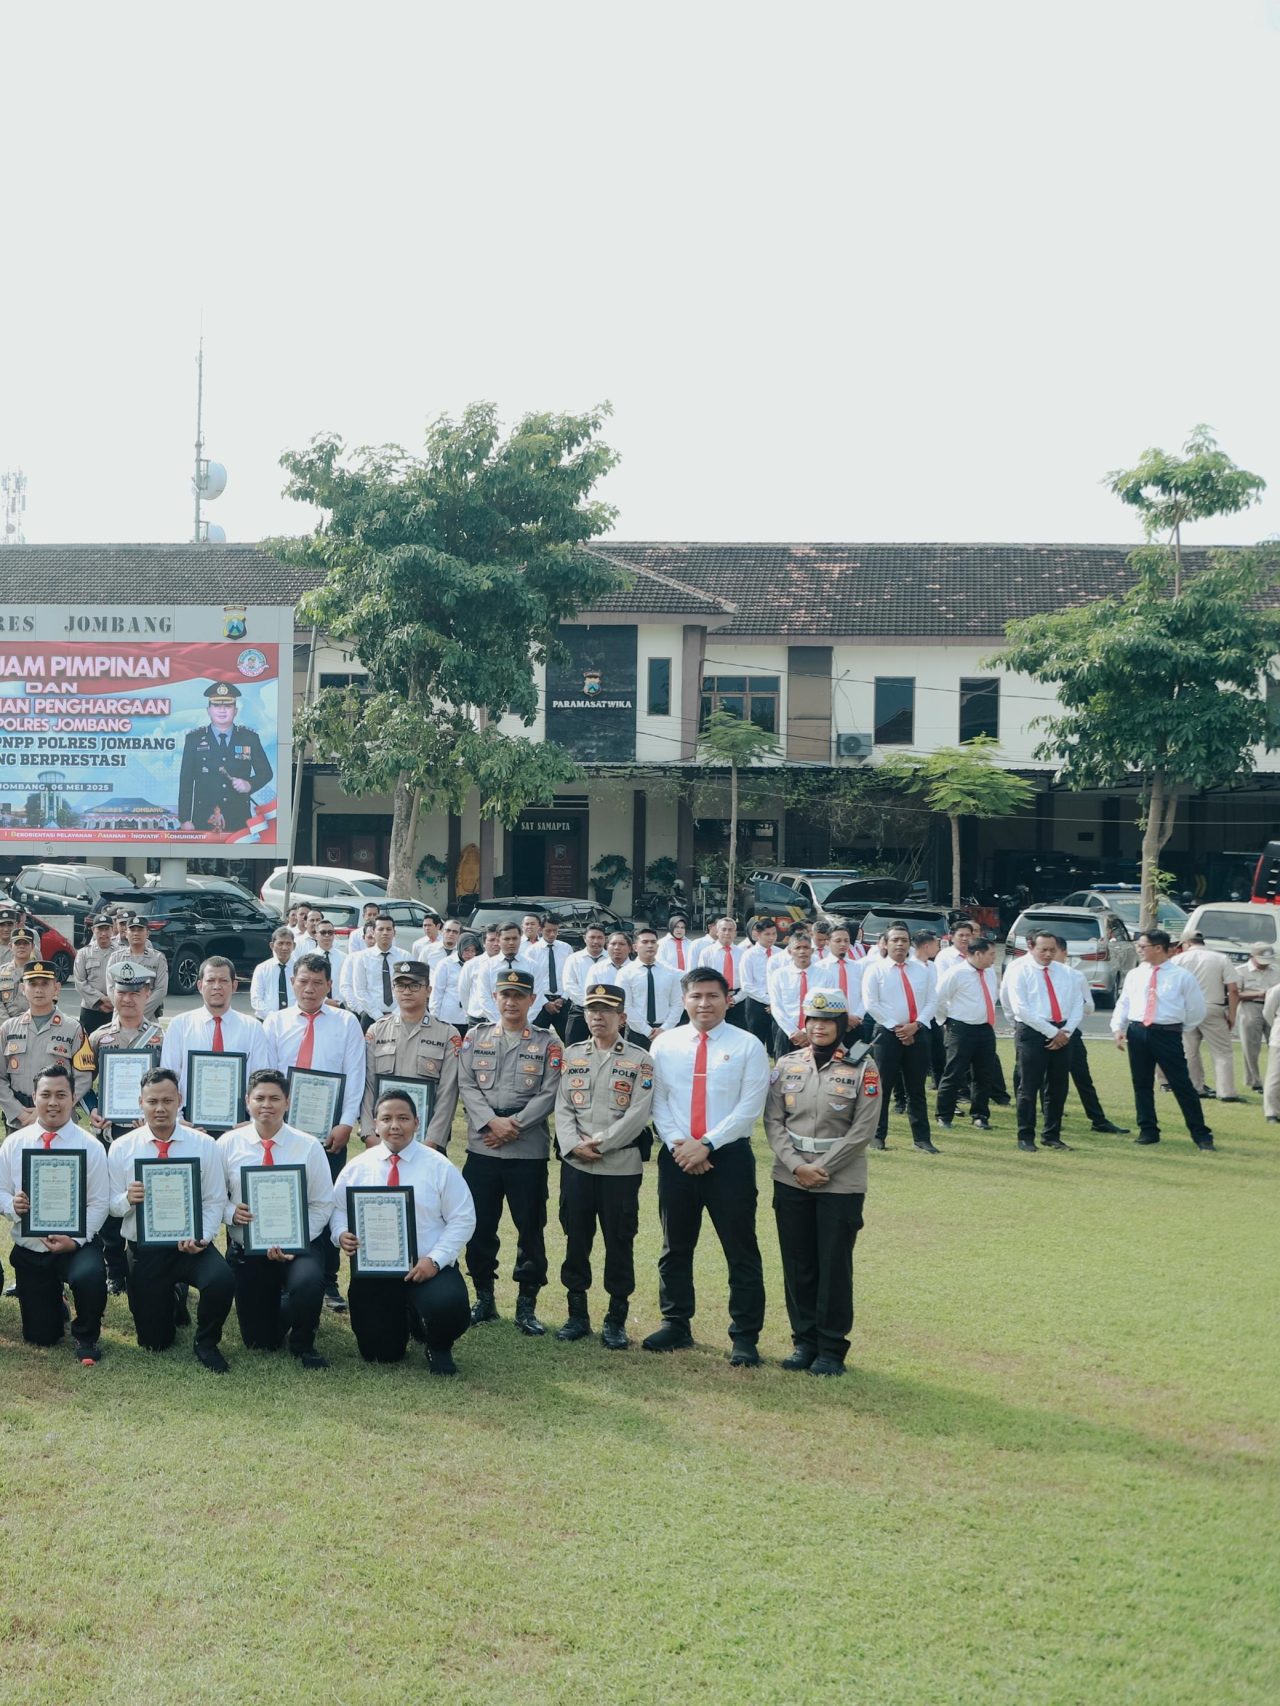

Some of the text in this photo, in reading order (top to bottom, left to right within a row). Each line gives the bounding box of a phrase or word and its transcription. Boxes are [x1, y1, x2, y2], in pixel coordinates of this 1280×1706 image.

[64, 615, 172, 633] JOMBANG
[50, 656, 170, 678] PIMPINAN
[25, 682, 78, 694] DAN
[34, 698, 170, 715] PENGHARGAAN
[552, 700, 632, 709] PARAMASATWIKA
[53, 718, 132, 733] JOMBANG
[37, 737, 97, 750] POLRES
[100, 737, 176, 751] JOMBANG
[19, 753, 127, 767] BERPRESTASI
[521, 822, 571, 831] SAT SAMAPTA
[420, 1039, 445, 1047] POLRI
[519, 1053, 544, 1061] POLRI
[612, 1069, 638, 1079] POLRI
[829, 1077, 856, 1086] POLRI
